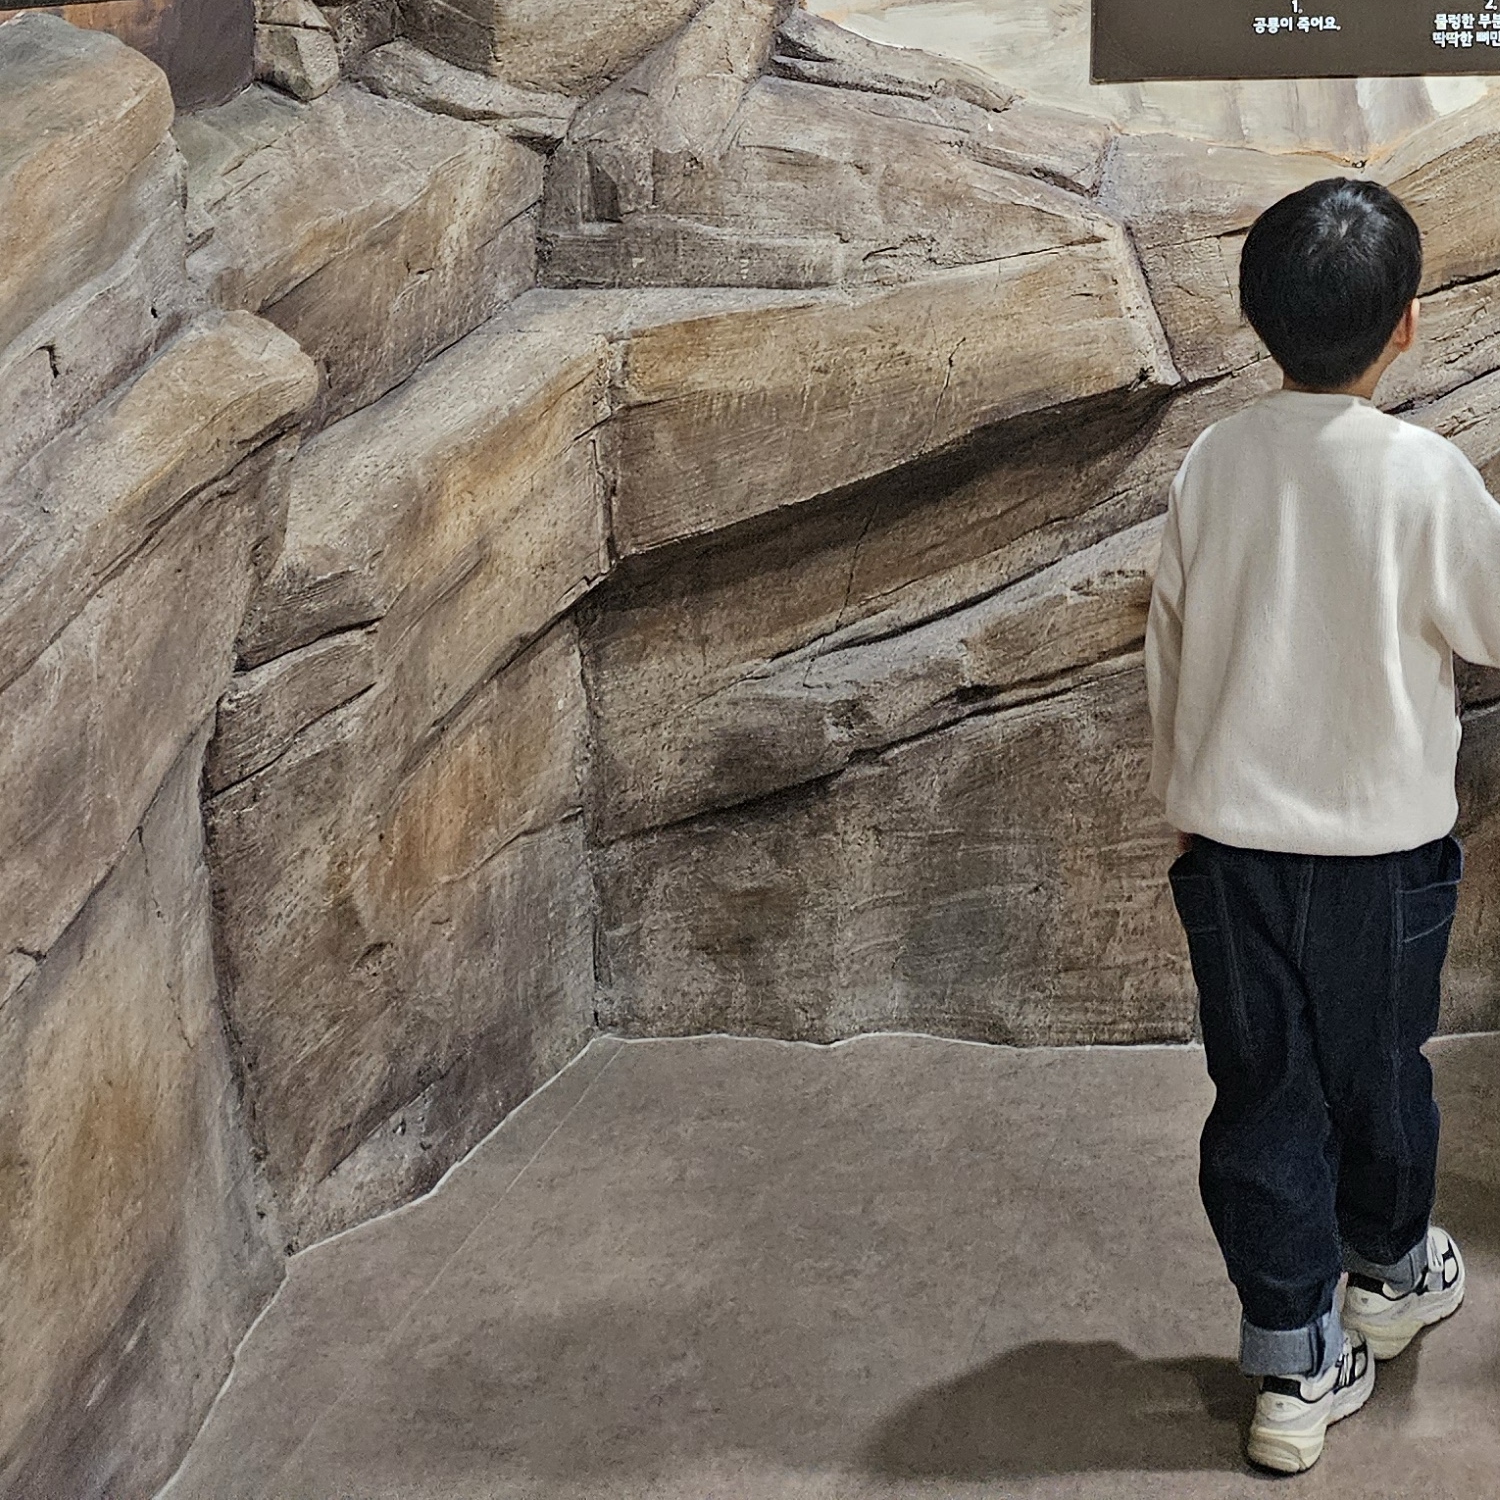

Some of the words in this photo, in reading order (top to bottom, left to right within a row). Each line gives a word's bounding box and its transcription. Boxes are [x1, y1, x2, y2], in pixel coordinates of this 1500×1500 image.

[1291, 0, 1303, 14] 1.
[1253, 16, 1293, 34] 공룡이
[1297, 16, 1341, 33] 죽어요.
[1434, 13, 1475, 30] 물렁한
[1432, 31, 1474, 48] 딱딱한
